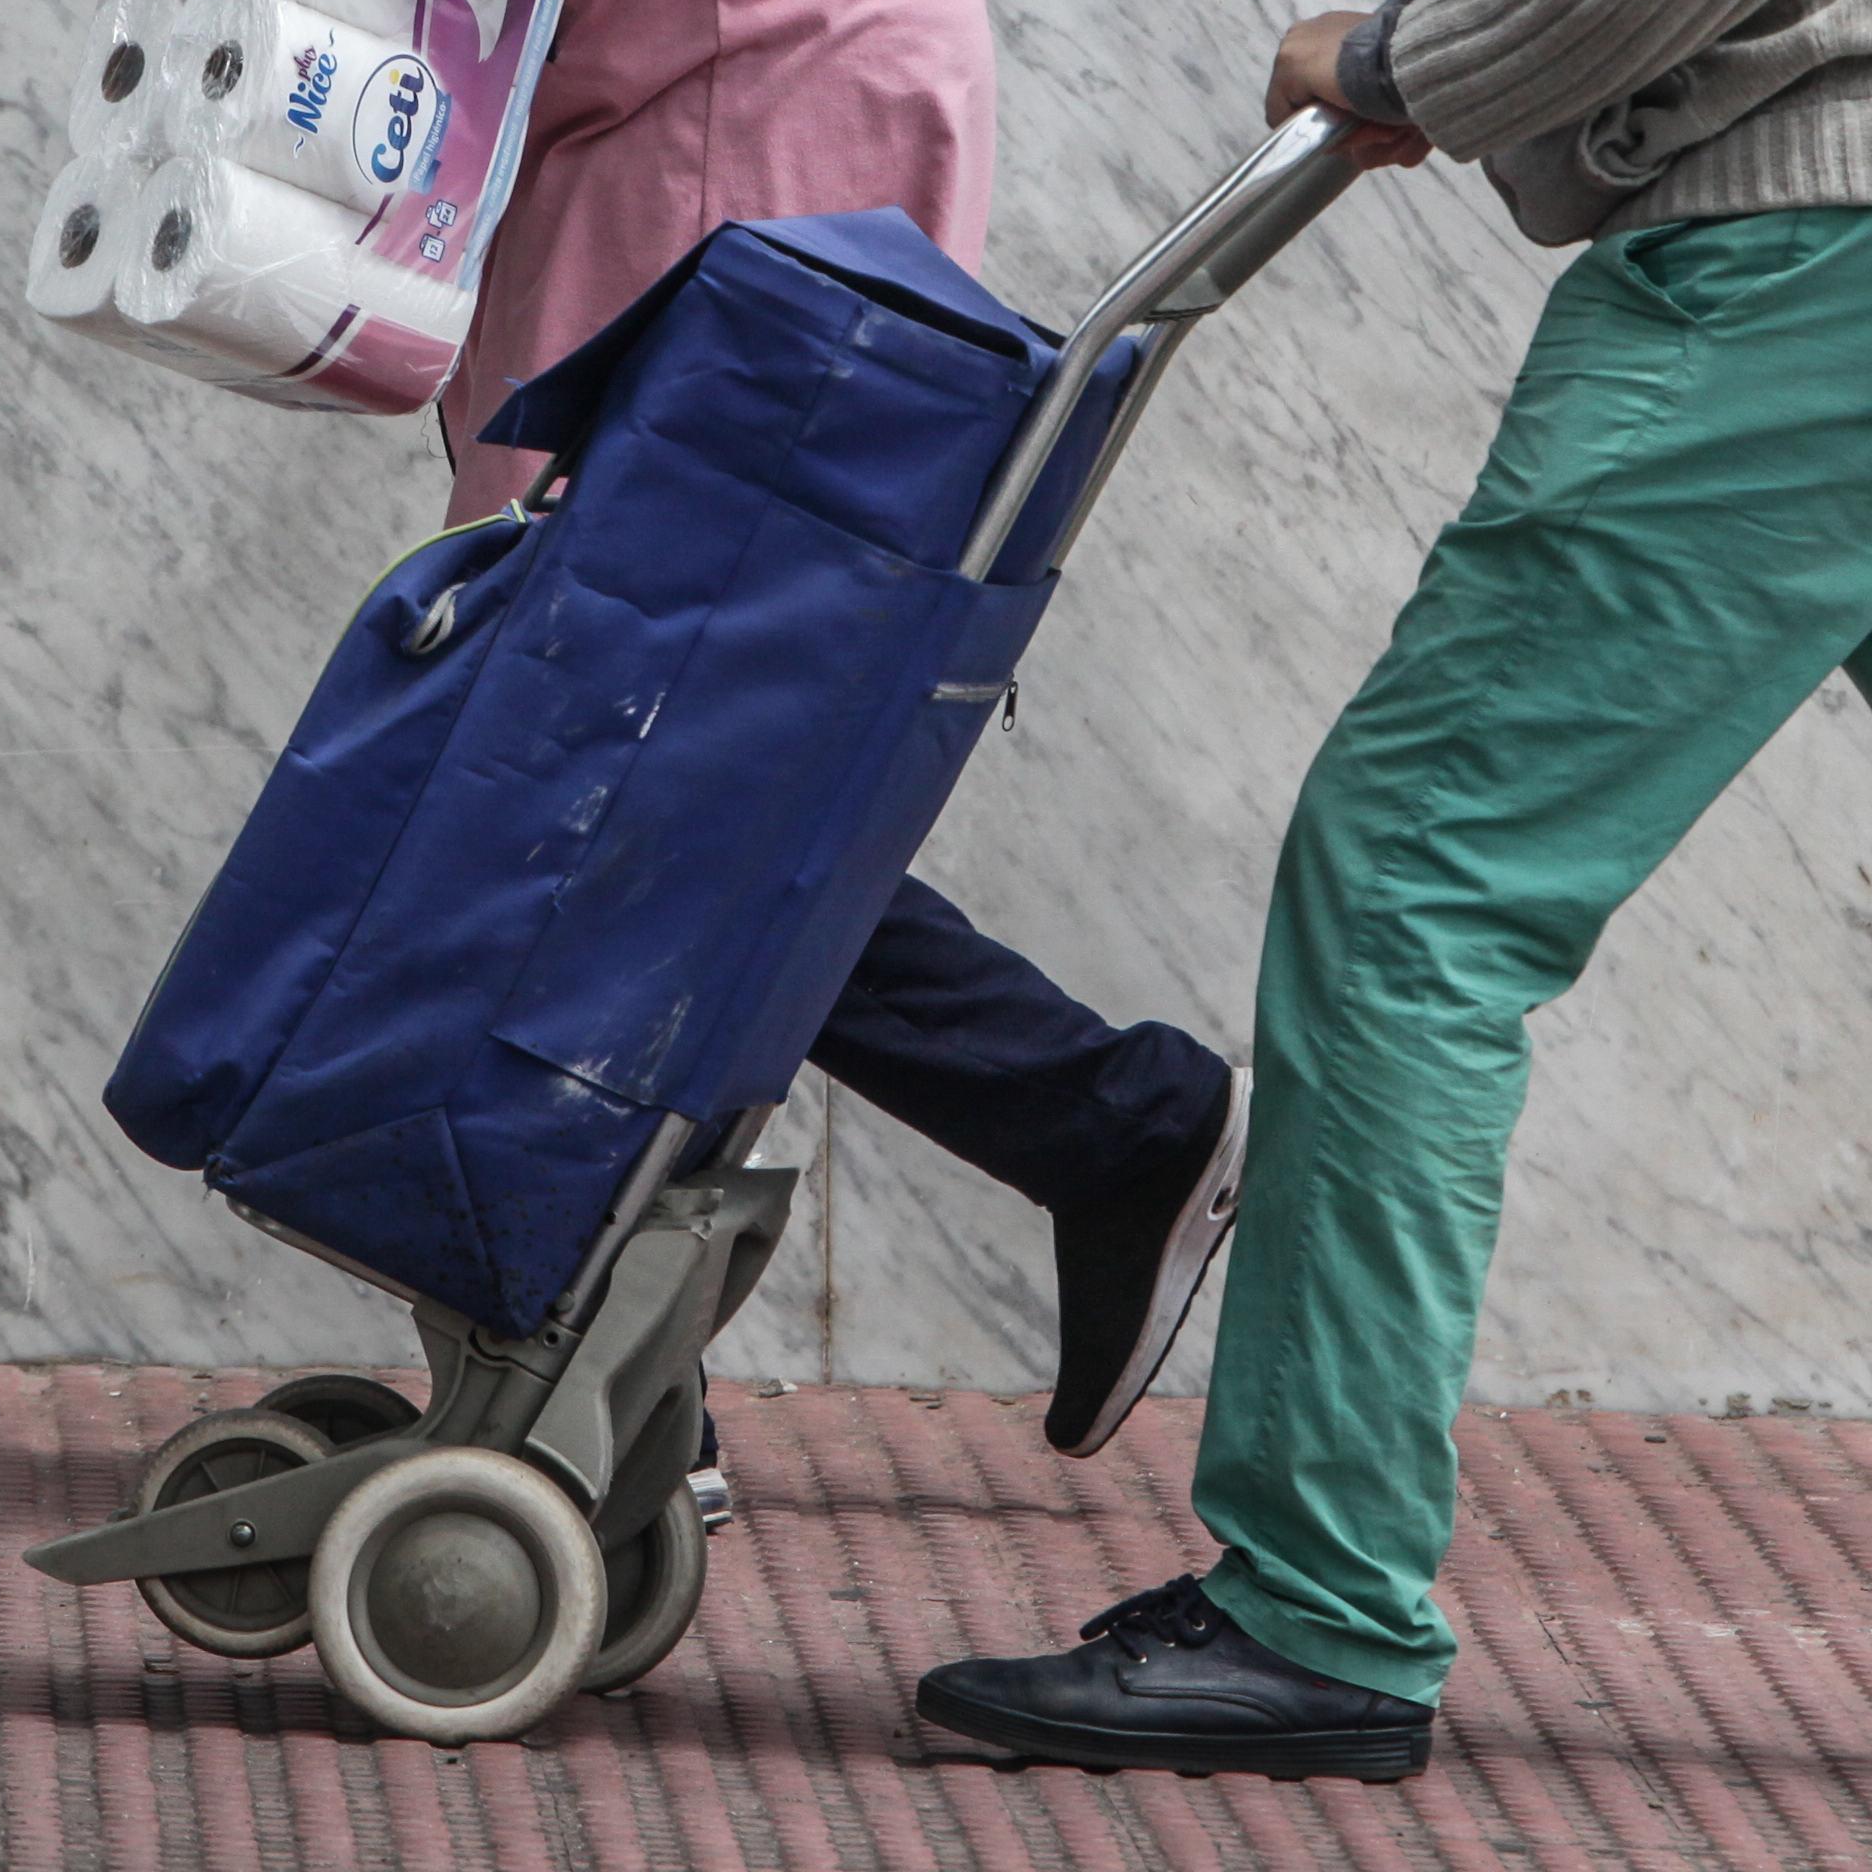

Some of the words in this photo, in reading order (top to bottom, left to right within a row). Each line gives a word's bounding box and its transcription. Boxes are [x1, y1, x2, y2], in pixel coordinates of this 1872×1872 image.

[294, 46, 317, 82] plus
[287, 53, 338, 135] Nice
[371, 66, 424, 183] Ceti
[414, 150, 430, 182] Papel
